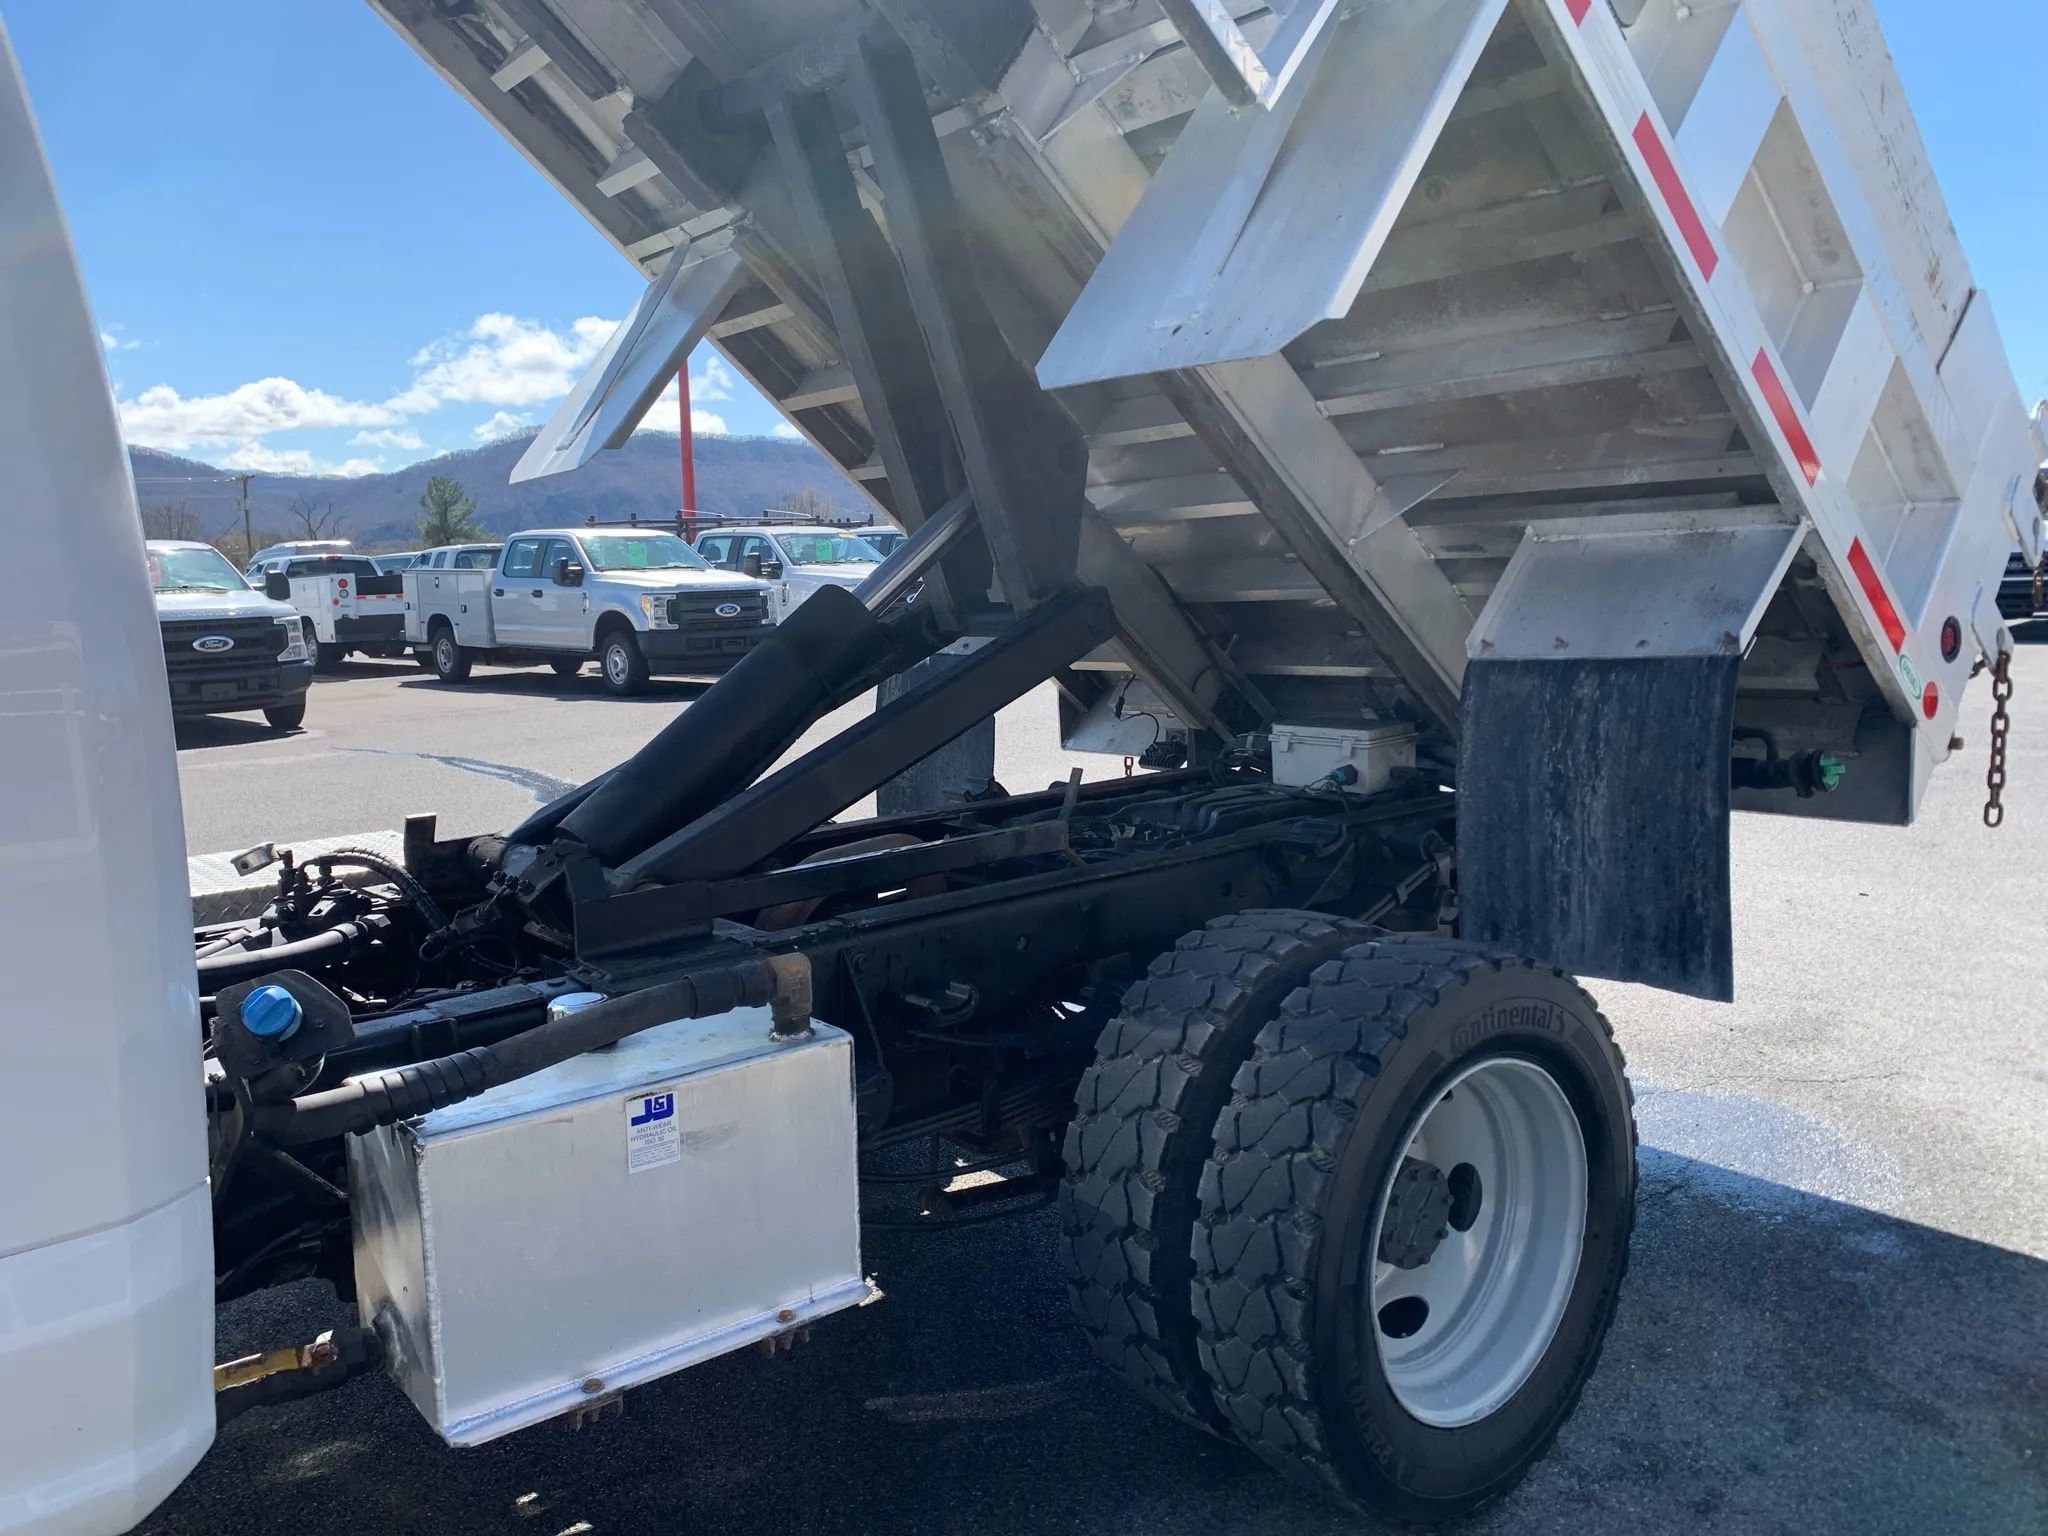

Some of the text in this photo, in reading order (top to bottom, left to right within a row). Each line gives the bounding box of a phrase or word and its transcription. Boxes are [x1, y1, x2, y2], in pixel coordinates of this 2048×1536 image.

[1450, 1004, 1554, 1054] Continental
[629, 1125, 677, 1143] HYDRAULIC OIL
[635, 1120, 673, 1135] ANTI-WEAR
[644, 1137, 657, 1146] ISO
